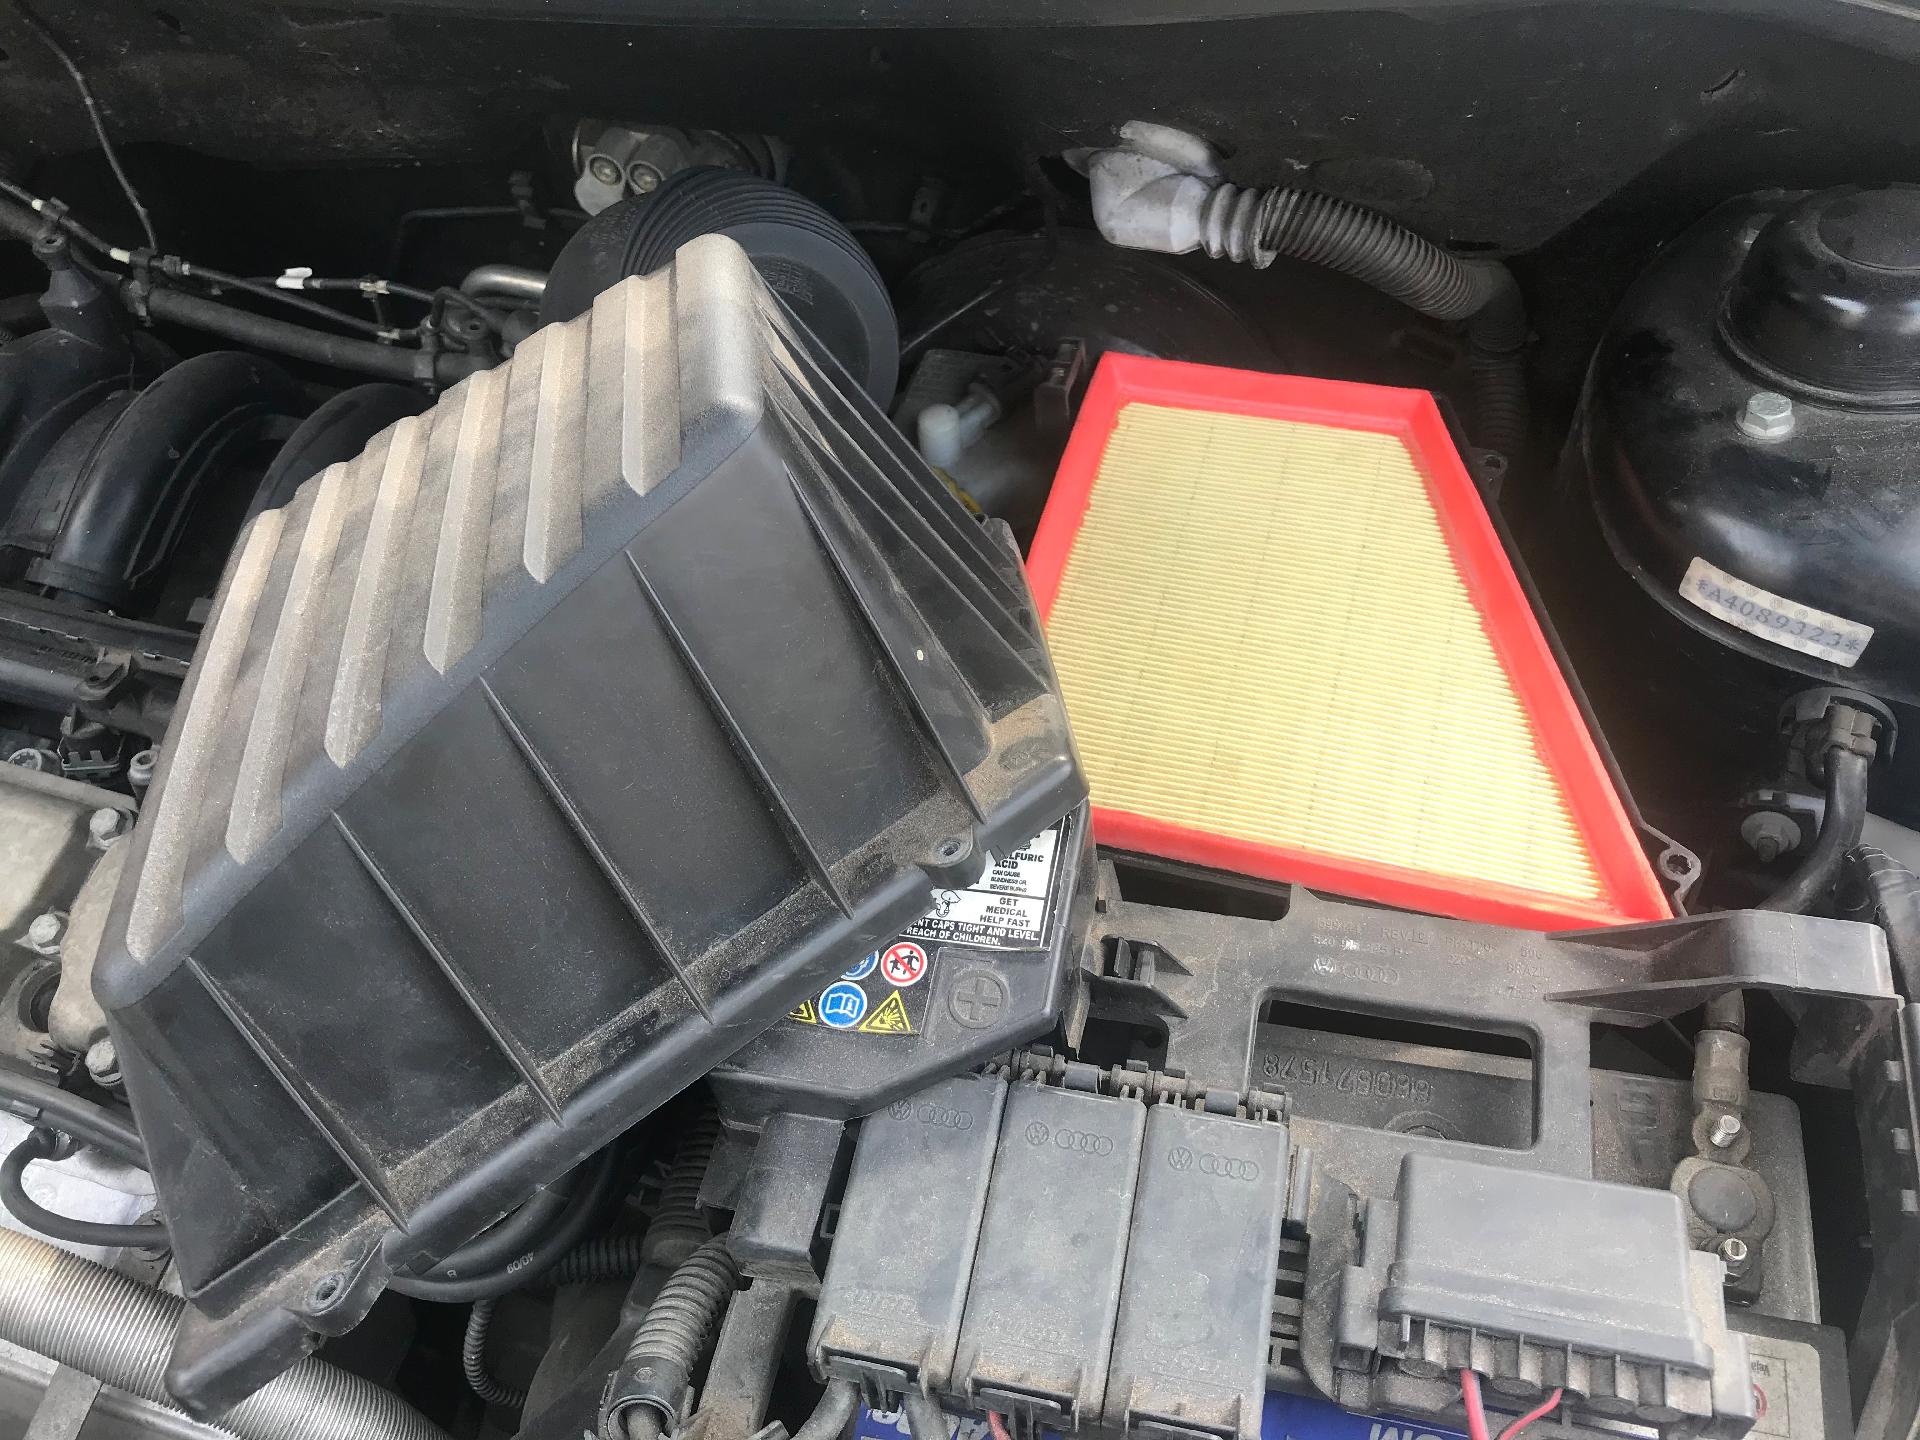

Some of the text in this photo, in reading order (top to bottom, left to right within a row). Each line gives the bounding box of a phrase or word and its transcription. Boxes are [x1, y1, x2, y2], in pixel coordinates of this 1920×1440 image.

[995, 860, 1019, 870] ACID
[999, 896, 1019, 907] GET
[985, 905, 1028, 918] MEDICAL
[979, 914, 1031, 928] HELP FAST
[906, 926, 1001, 946] REACH OF CHILDREN.
[931, 919, 956, 931] CAPS
[958, 922, 986, 935] TIGHT
[986, 925, 1006, 937] AND
[1007, 928, 1040, 941] LEVEL.
